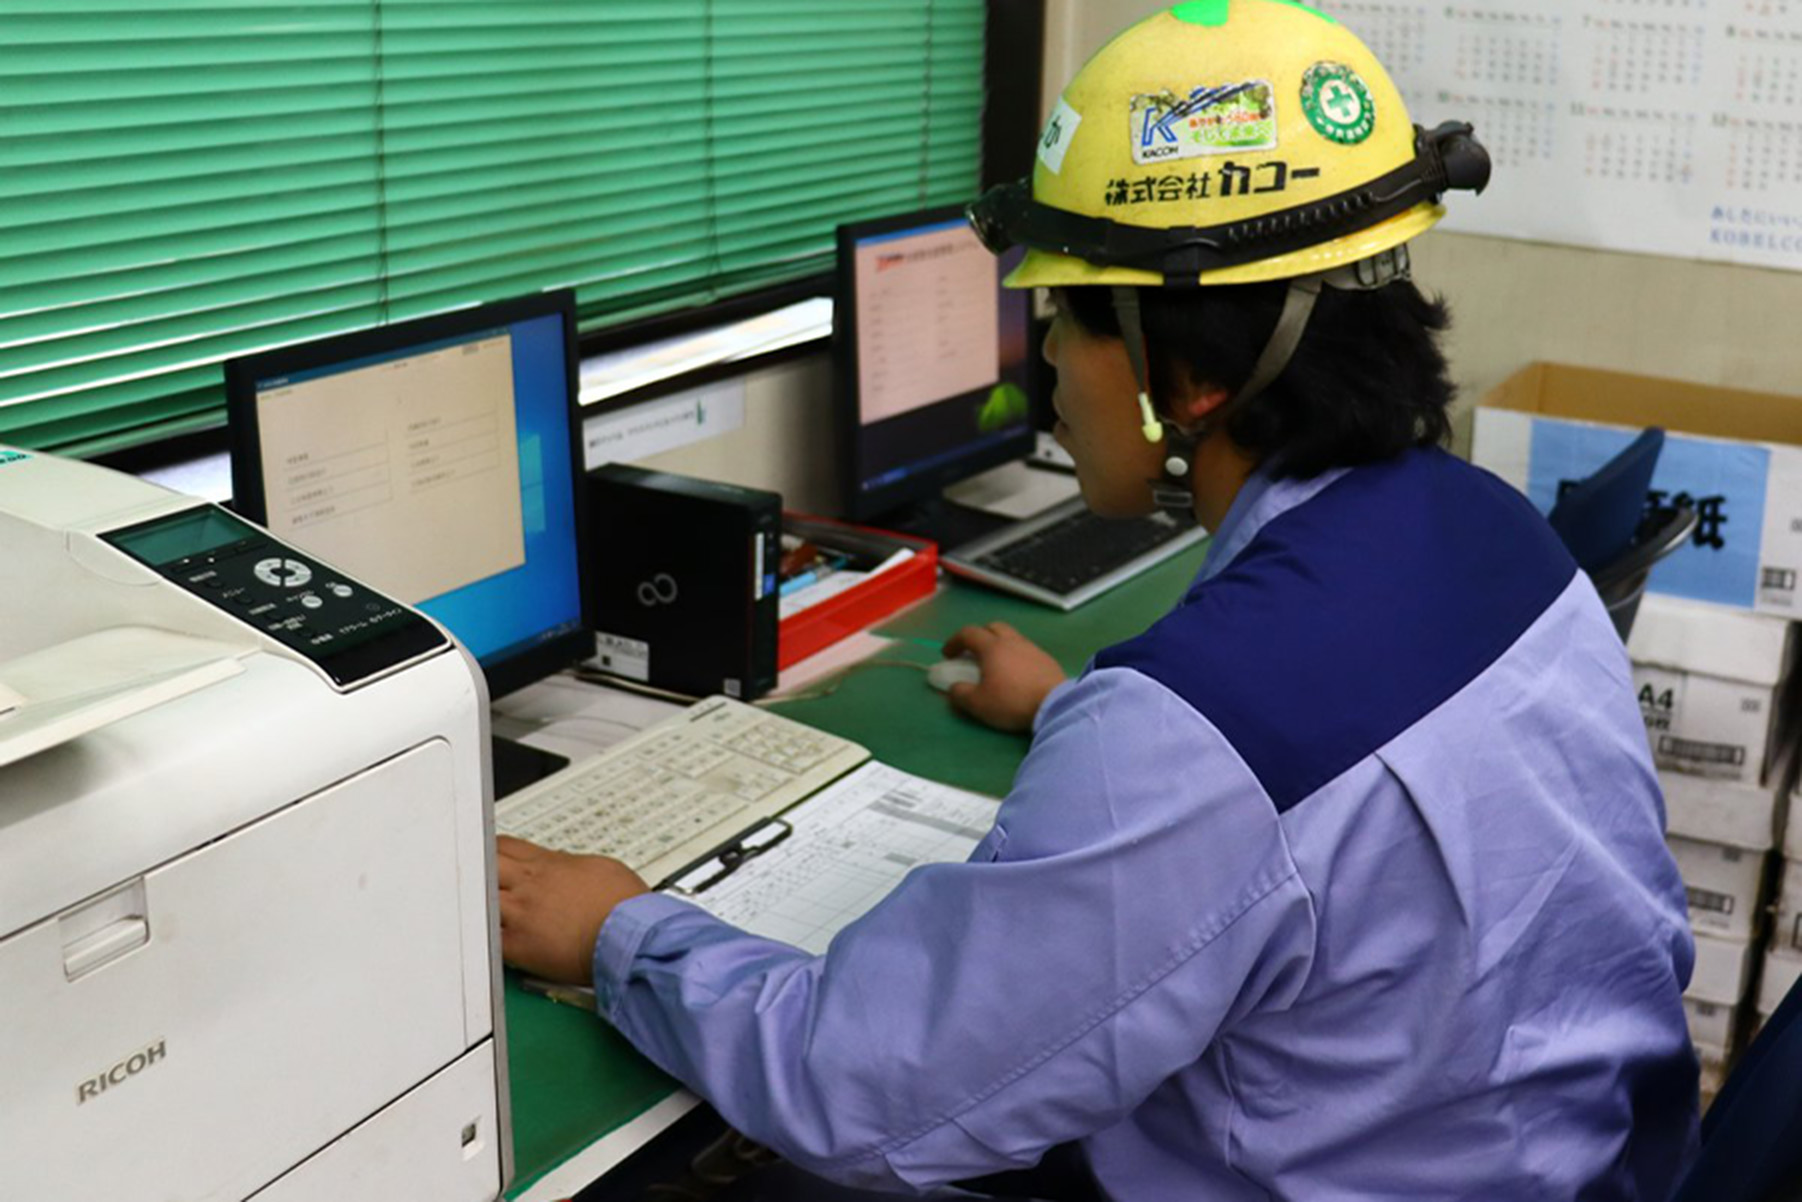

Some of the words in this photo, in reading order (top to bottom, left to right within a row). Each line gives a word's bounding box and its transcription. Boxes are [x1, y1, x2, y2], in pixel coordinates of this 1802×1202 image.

[1142, 146, 1179, 159] KACOH
[1638, 683, 1673, 710] A4
[78, 1039, 167, 1104] RICOH
